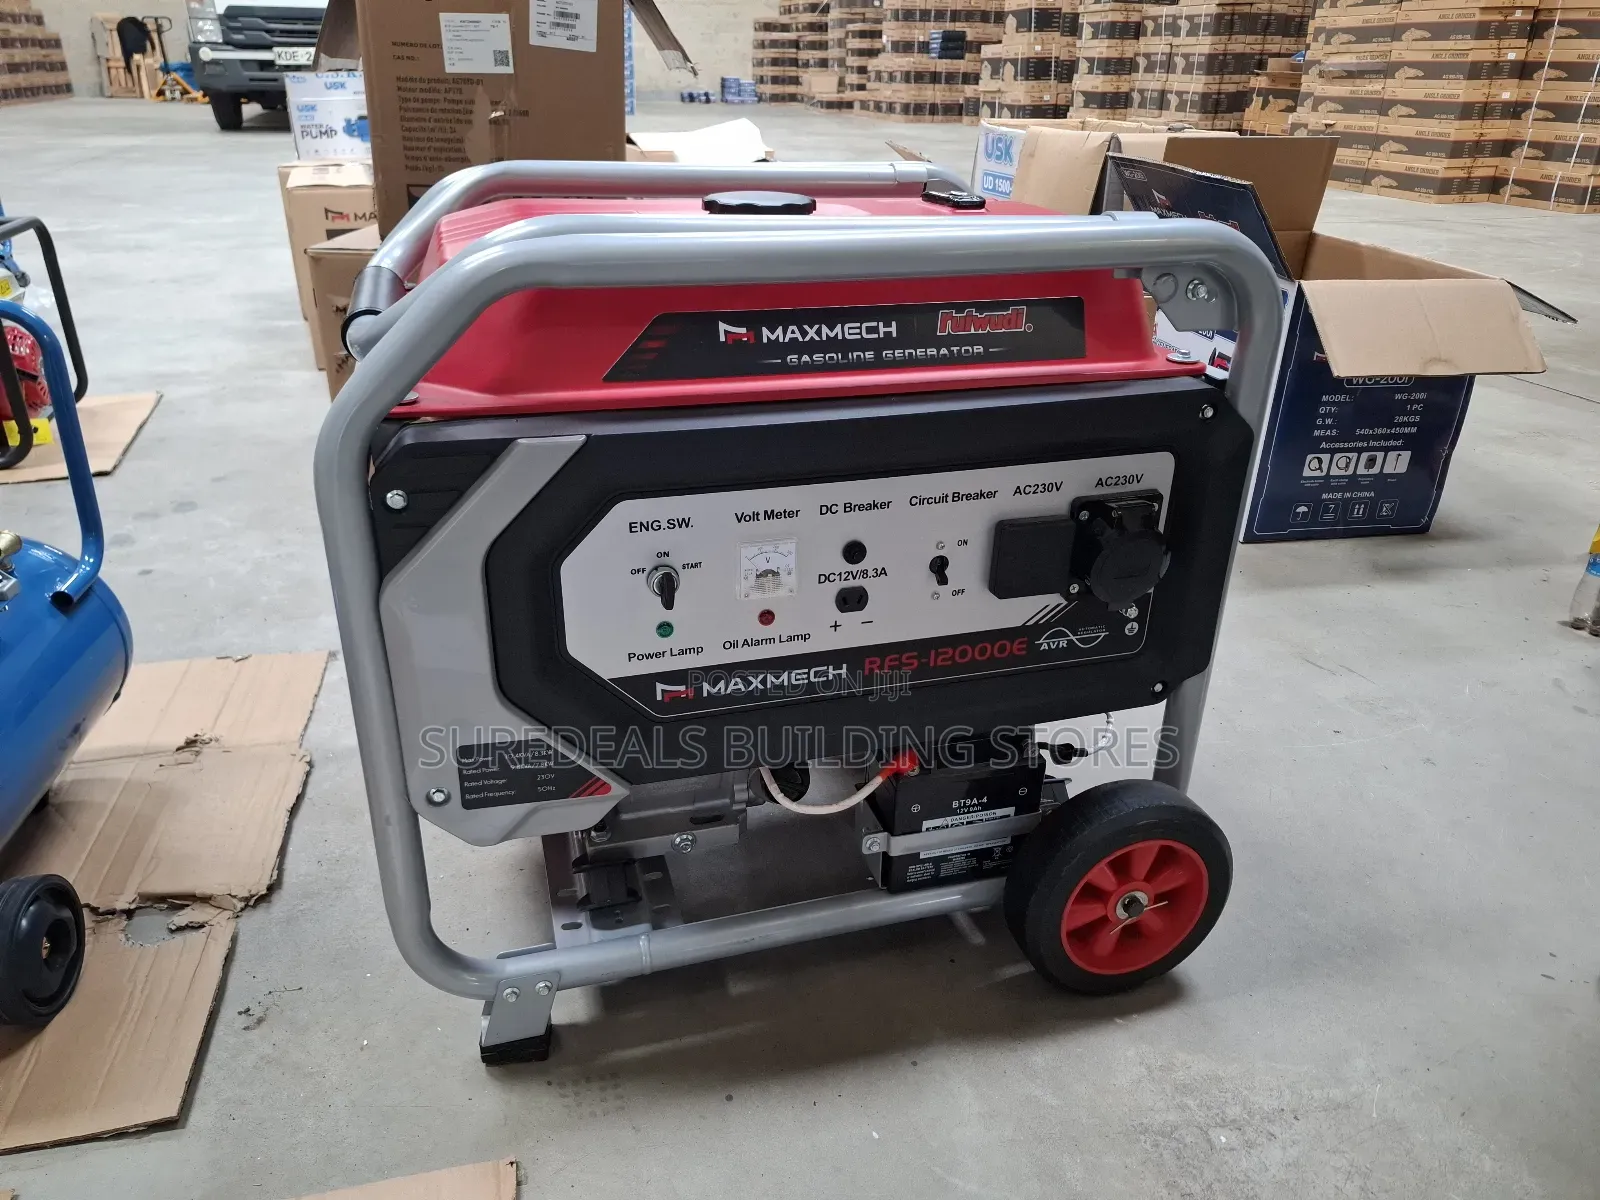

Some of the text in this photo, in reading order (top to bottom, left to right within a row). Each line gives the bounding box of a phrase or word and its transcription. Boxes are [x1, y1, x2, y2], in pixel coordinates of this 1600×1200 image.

[277, 50, 298, 61] KDE
[323, 81, 347, 90] USK
[296, 104, 318, 112] USK
[301, 129, 338, 140] PUMP
[1430, 131, 1451, 139] GRINDER
[1554, 134, 1572, 142] ANGLE
[984, 132, 1015, 166] USK
[1404, 165, 1440, 176] ANGLE GRINDER
[983, 176, 994, 189] UD
[761, 320, 897, 344] MAXMECH
[786, 345, 984, 366] GASOLINE GENERATOR
[1321, 392, 1428, 402] MODEL: WG-200i
[1319, 406, 1339, 414] QTY:
[1394, 415, 1421, 423] 28KGS
[1313, 426, 1418, 437] MEAS: 540x360x450MM
[1320, 439, 1405, 449] Accessories Included:
[1094, 473, 1144, 488] AC230V
[1012, 480, 1064, 497] AC230V
[908, 489, 999, 507] Circuit Breaker
[1321, 492, 1343, 500] MADE
[819, 499, 893, 516] DC Breaker
[734, 508, 801, 524] Volt Meter
[628, 516, 694, 534] ENG.SW.
[957, 538, 969, 547] ON
[656, 550, 670, 559] ON
[765, 556, 771, 564] V
[681, 561, 703, 570] START
[630, 567, 647, 576] OFF
[817, 566, 888, 585] DC12V/8.3A
[951, 588, 966, 597] OFF
[722, 631, 812, 651] Oil Alarm Lamp
[1039, 640, 1068, 651] AVR
[627, 645, 704, 662] Power Lamp
[702, 637, 1029, 697] MAXMECH RFS-12000E
[464, 780, 483, 788] Rated
[536, 773, 555, 781] 230V
[465, 792, 484, 800] Rated
[537, 785, 557, 793] 50Hz
[952, 796, 988, 808] BT9A-4
